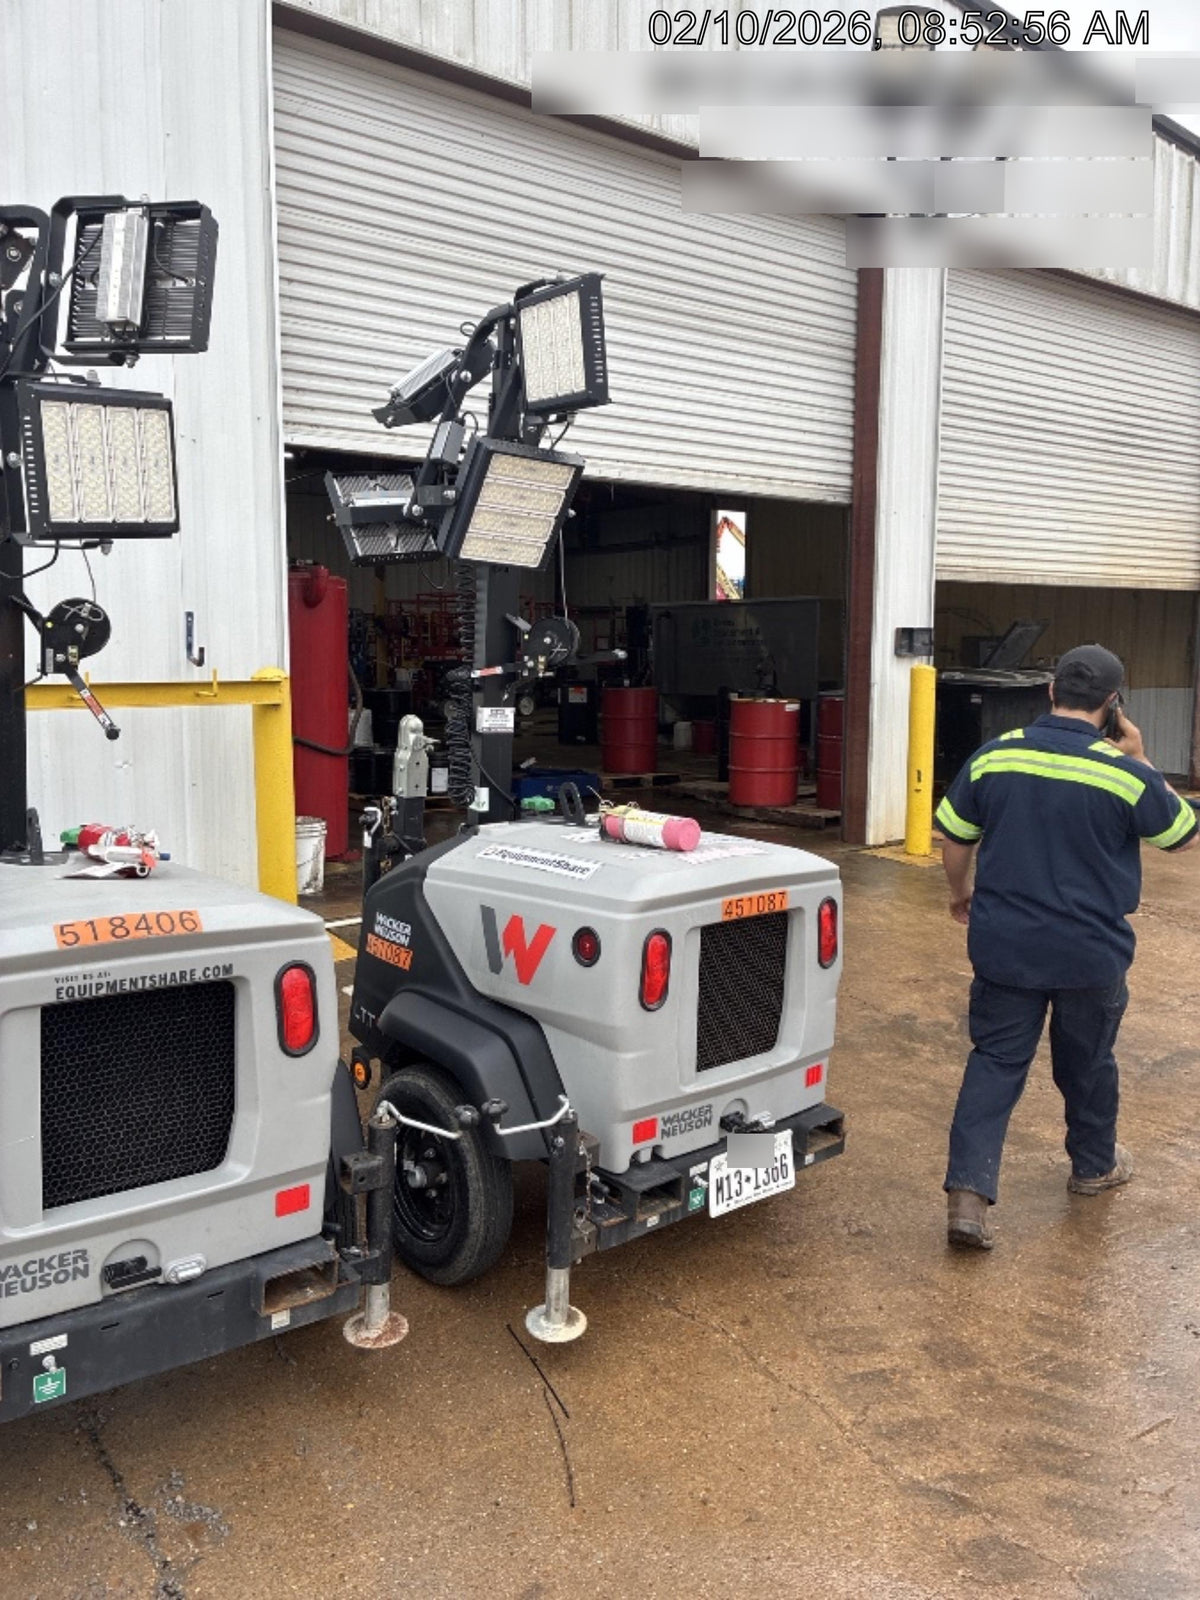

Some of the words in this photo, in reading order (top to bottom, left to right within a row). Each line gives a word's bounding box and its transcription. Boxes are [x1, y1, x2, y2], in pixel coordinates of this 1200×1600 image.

[723, 891, 787, 918] 451087
[58, 910, 199, 946] 518406
[55, 963, 234, 1000] EQUIPMENTSHARE.COM
[660, 1116, 713, 1141] NEUSON
[661, 1103, 713, 1127] WACKER
[0, 1263, 90, 1298] EUSON
